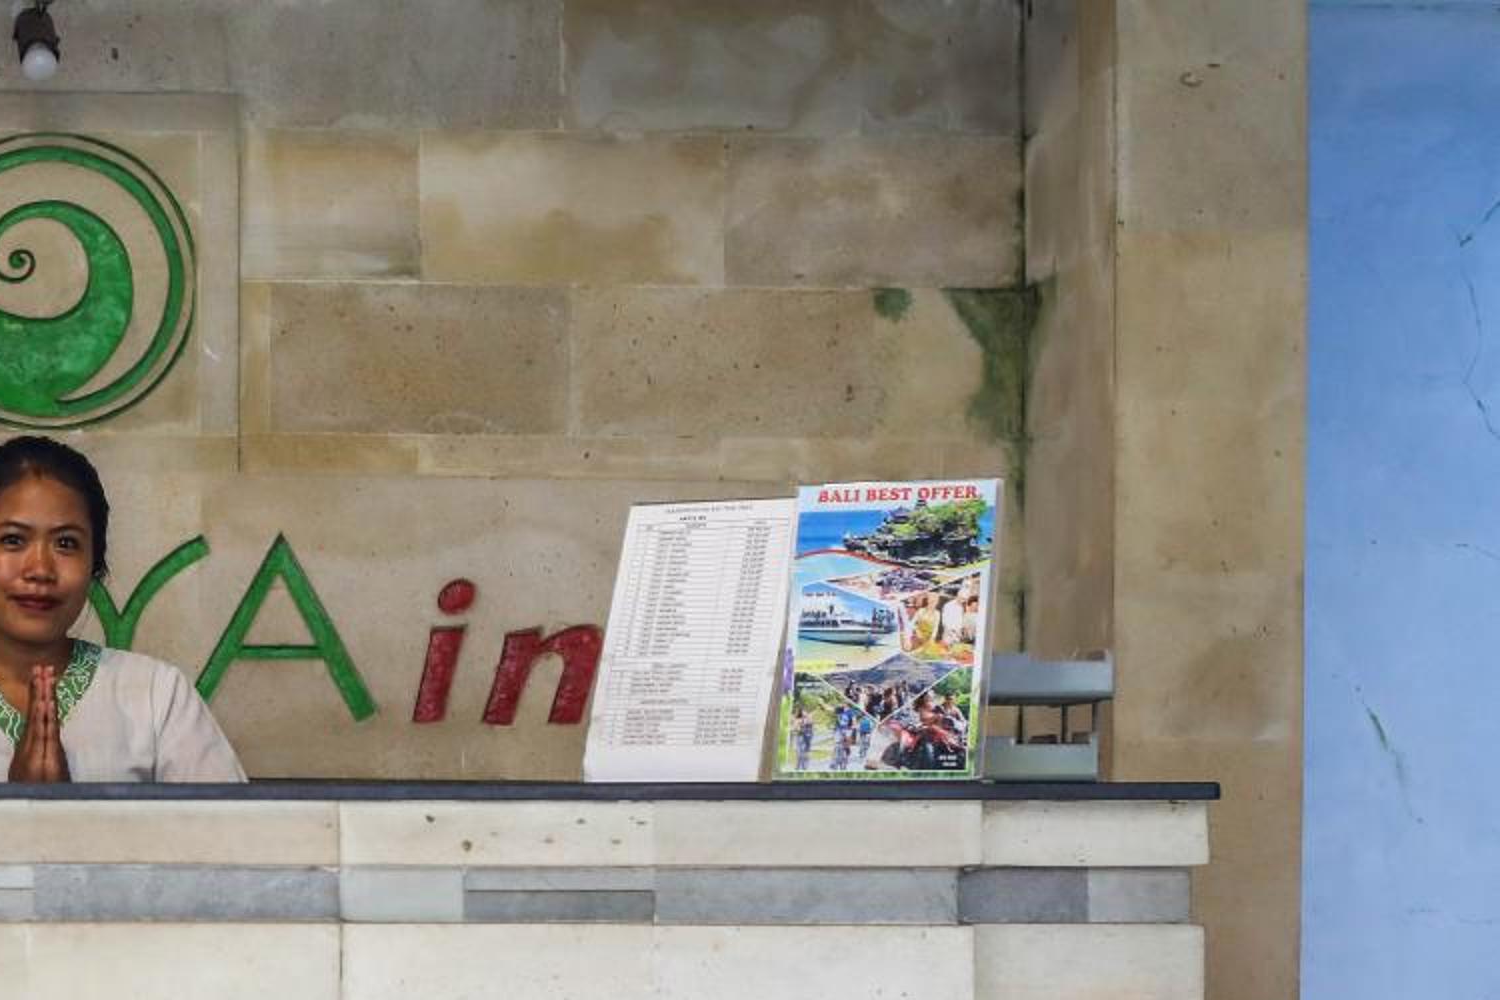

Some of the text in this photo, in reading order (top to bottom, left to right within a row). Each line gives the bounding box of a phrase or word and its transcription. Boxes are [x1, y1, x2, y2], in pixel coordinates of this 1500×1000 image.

[818, 486, 977, 502] BALI BEST OFFER
